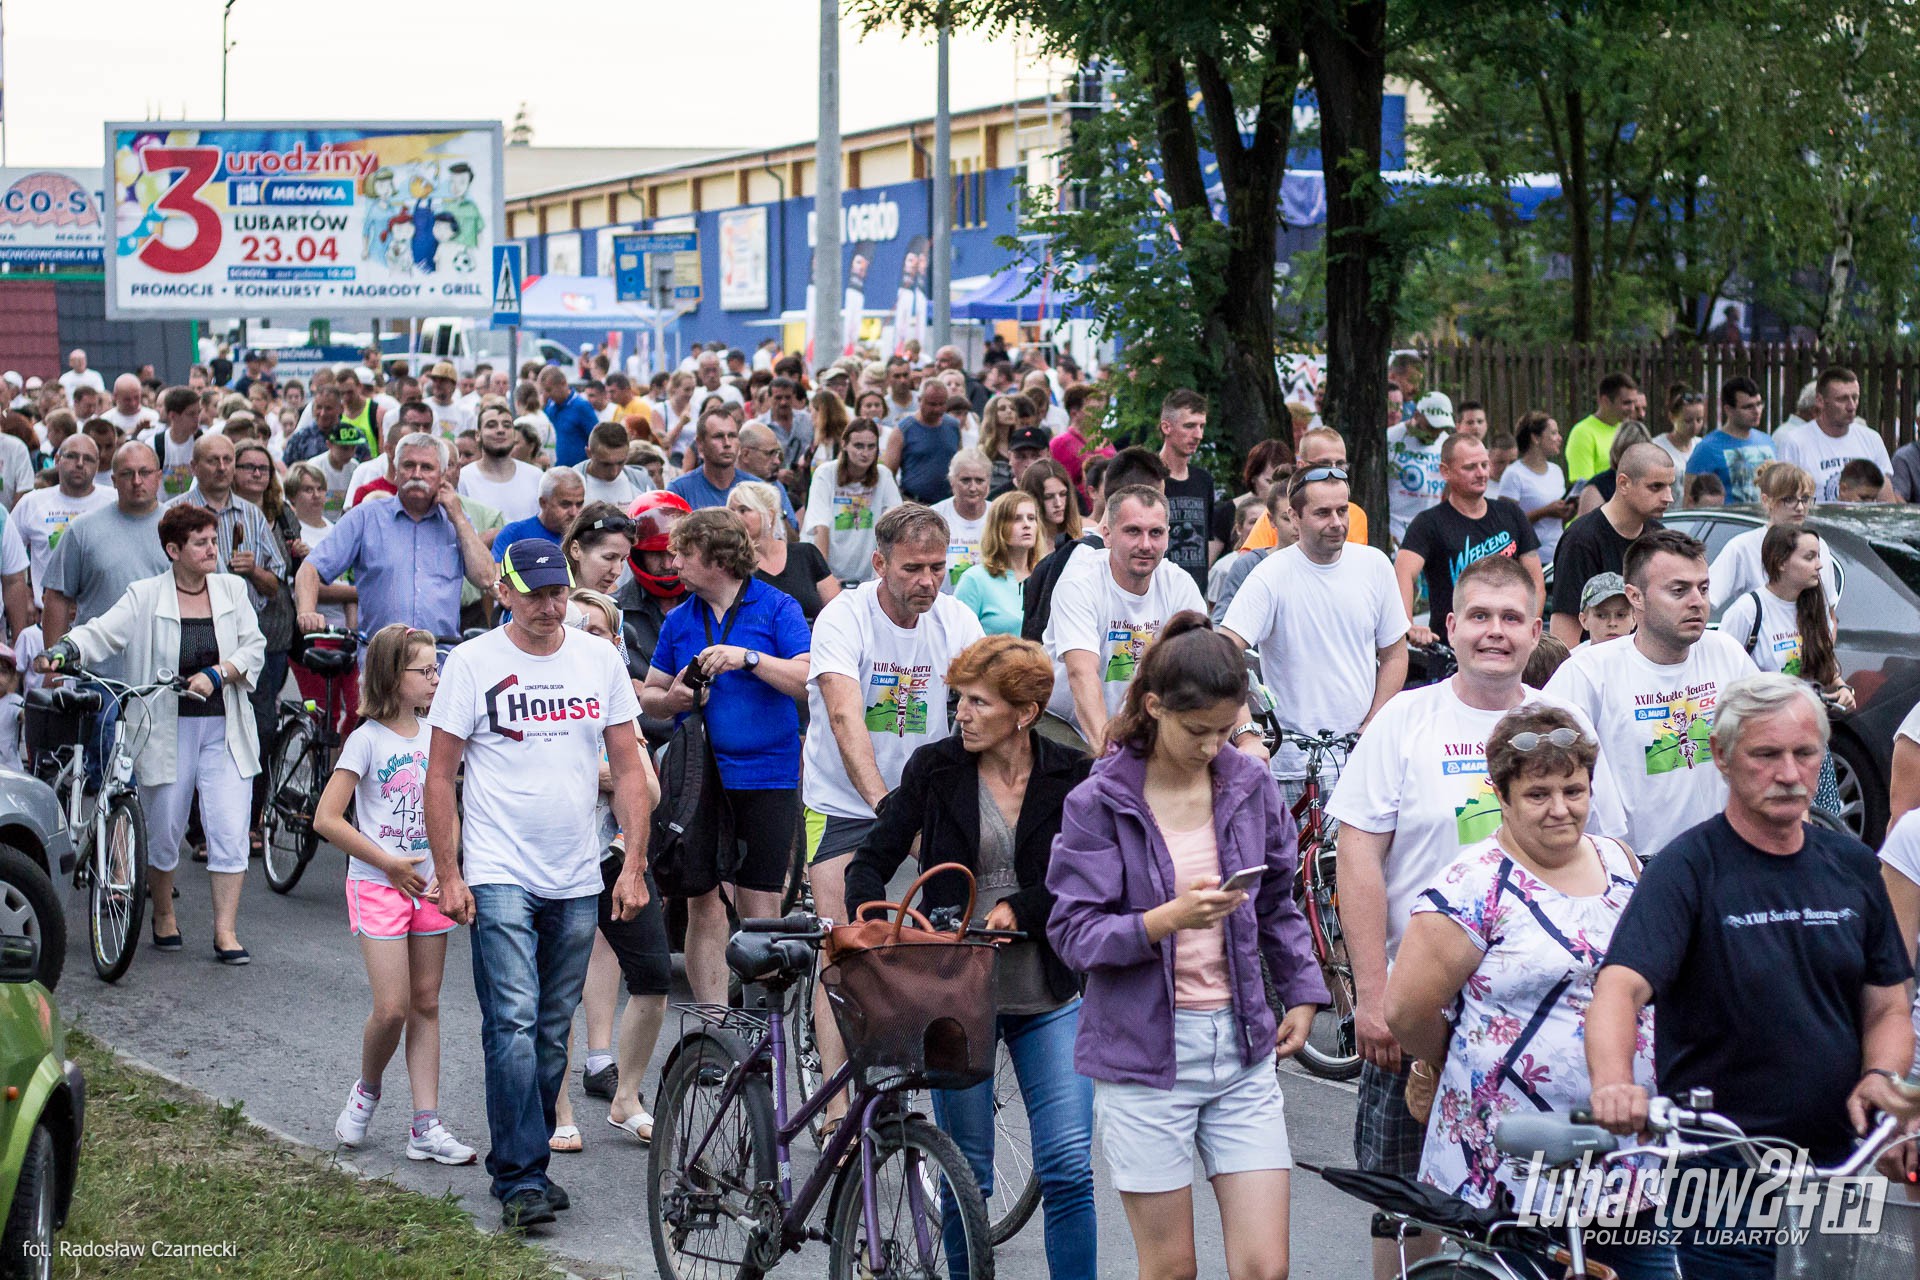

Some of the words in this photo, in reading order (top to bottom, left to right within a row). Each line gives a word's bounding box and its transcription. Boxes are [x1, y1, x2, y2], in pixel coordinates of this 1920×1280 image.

[227, 142, 378, 175] urodziny
[272, 182, 346, 201] MRÓWKA
[139, 148, 223, 274] 3
[234, 210, 348, 232] LUBARTÓW
[848, 192, 899, 243] OGRÓD
[241, 236, 339, 262] 23.04
[131, 283, 214, 297] PROMOCJE
[235, 283, 321, 297] KONKURSY
[342, 283, 421, 297] NAGRODY
[442, 282, 483, 296] GRILL
[1448, 530, 1511, 588] WEEKEND
[507, 691, 600, 722] House
[1634, 693, 1654, 706] XXIII
[1444, 742, 1472, 756] XXIII
[1461, 762, 1488, 771] MAPE
